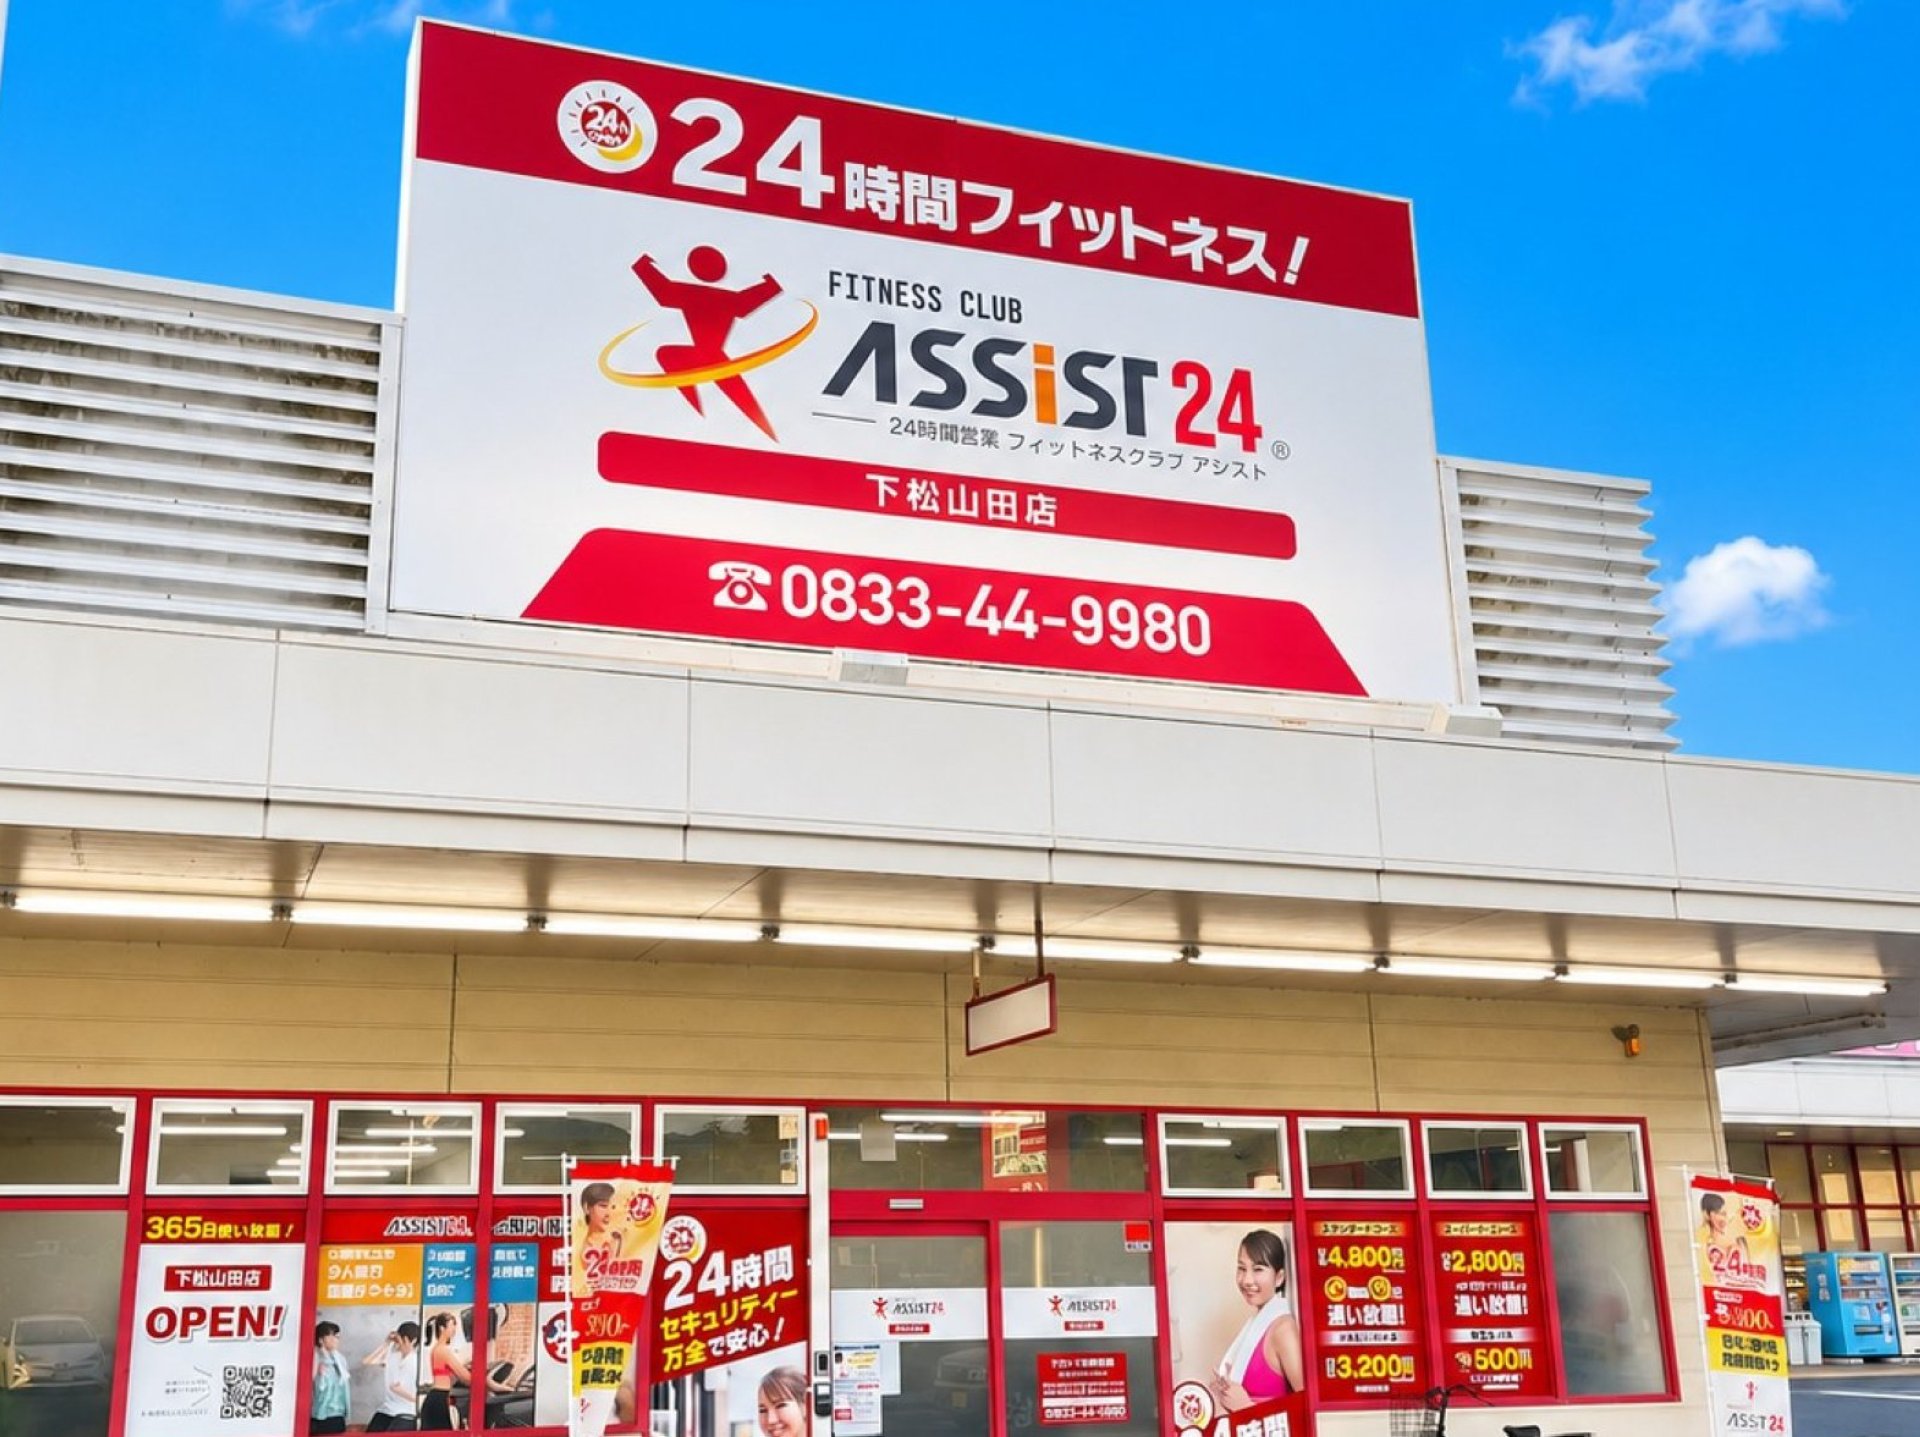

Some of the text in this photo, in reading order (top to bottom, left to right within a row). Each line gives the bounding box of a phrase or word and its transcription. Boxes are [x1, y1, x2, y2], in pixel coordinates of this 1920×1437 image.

[670, 97, 1309, 285] 24時間フィットネス!
[829, 271, 1023, 324] FITNESS CLUB
[889, 416, 1266, 481] 24時間営業 フィットネスクラブ アシスト
[866, 473, 1057, 528] 下松山田店
[780, 564, 1210, 657] 0833-44-9980
[663, 1245, 794, 1311] 24時間
[146, 1305, 285, 1340] OPEN!
[660, 1289, 798, 1341] セキュリティー
[662, 1317, 785, 1372] 万全で安心!
